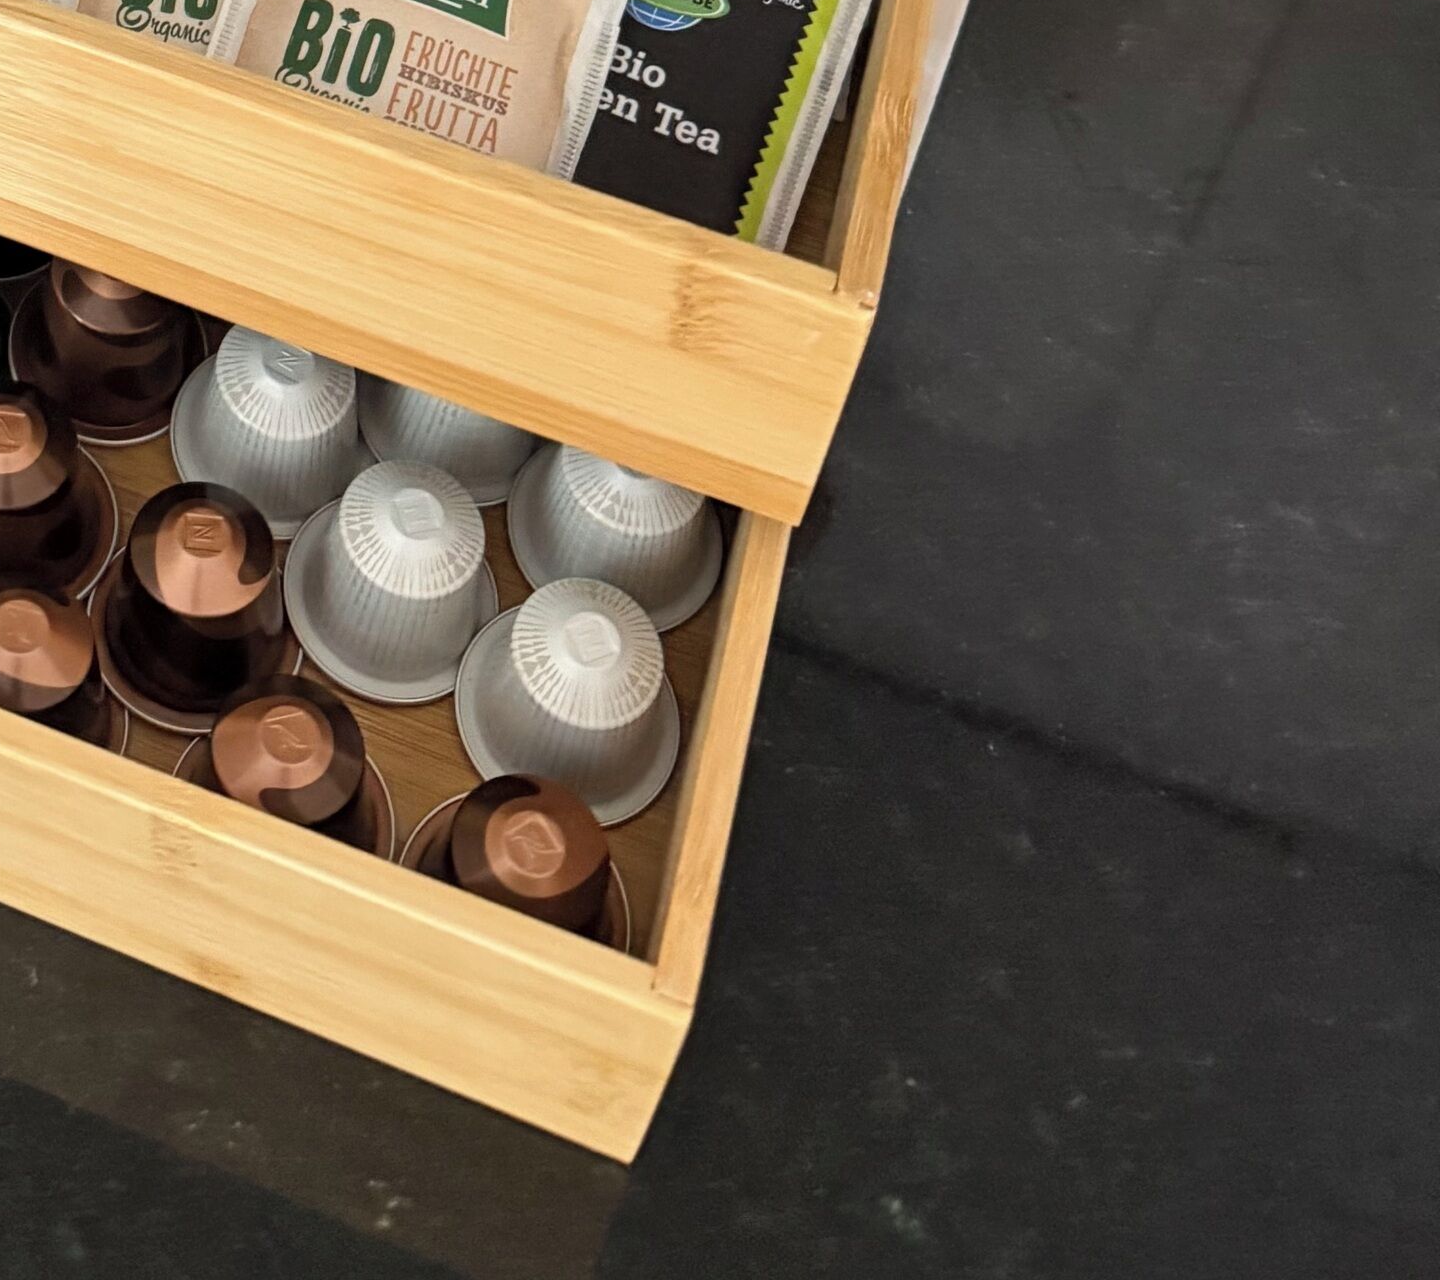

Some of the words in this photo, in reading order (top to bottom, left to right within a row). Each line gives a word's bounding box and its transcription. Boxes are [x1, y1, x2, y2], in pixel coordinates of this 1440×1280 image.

[116, 3, 212, 45] Organic
[398, 63, 509, 116] HIBISKUS
[401, 30, 519, 100] FRÜCHTE
[609, 43, 667, 88] Bio
[385, 82, 499, 153] FRUTTA
[653, 101, 721, 155] Tea
